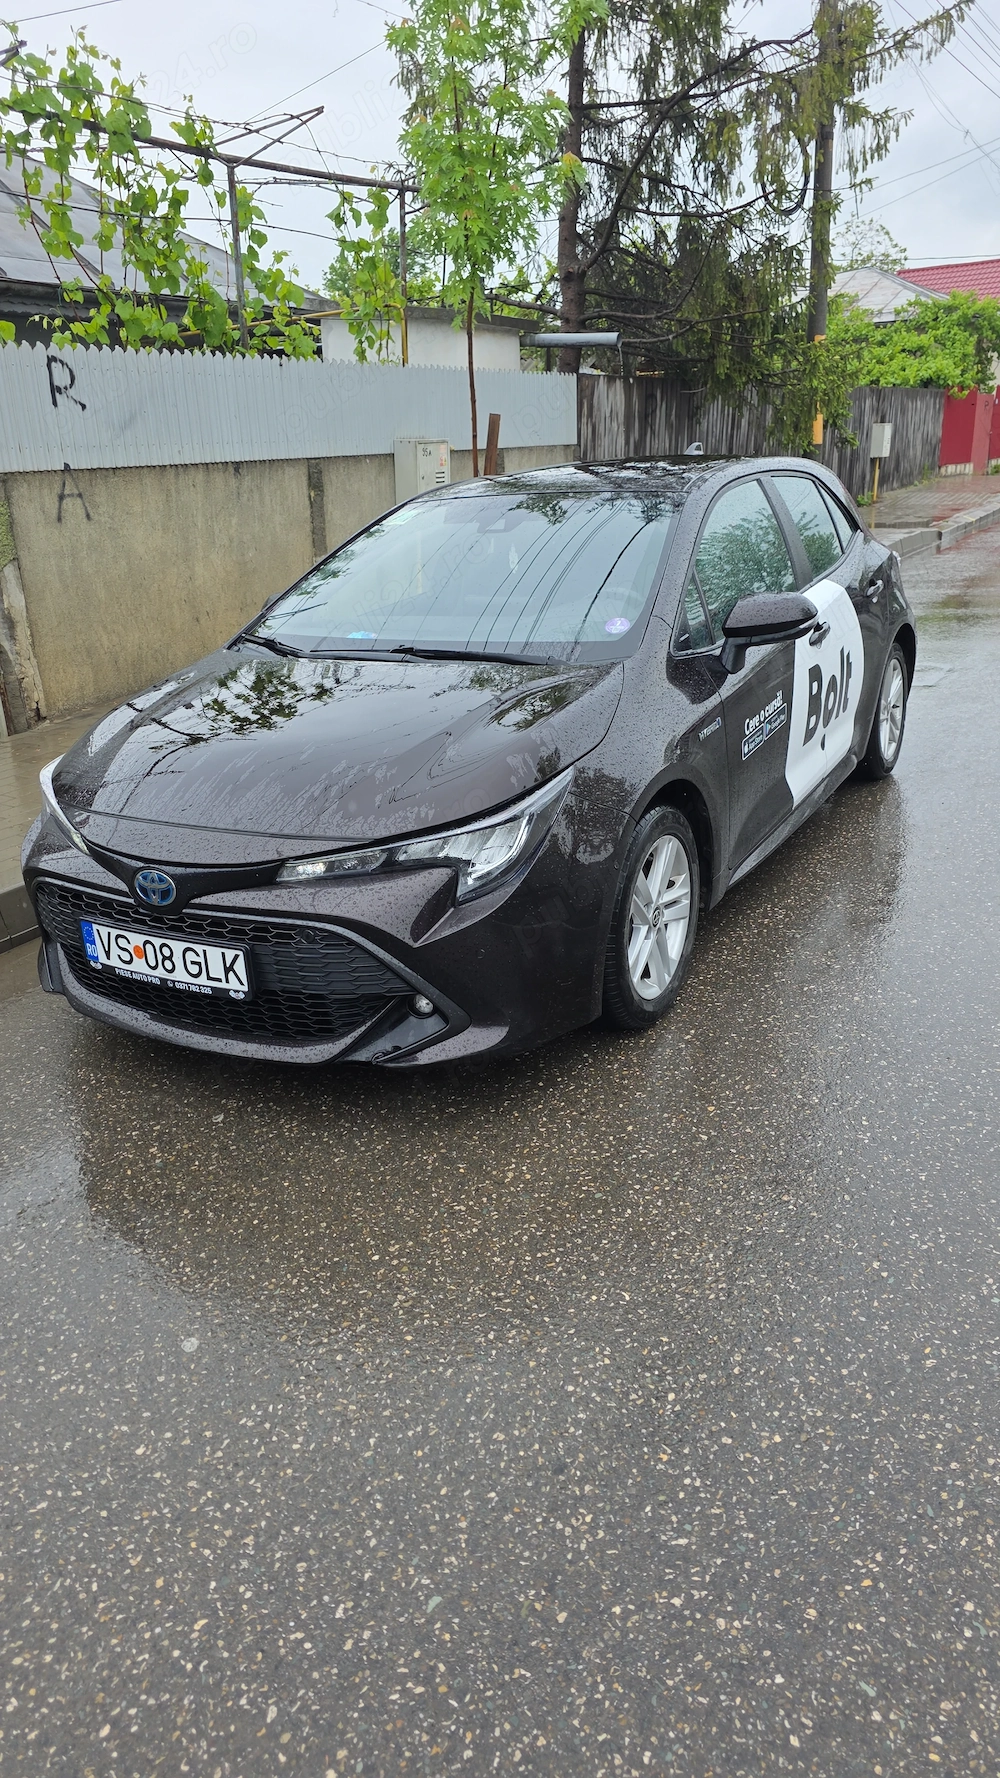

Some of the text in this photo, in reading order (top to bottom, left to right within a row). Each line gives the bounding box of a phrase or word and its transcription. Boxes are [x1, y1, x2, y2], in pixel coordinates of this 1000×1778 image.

[47, 354, 87, 412] R
[57, 462, 92, 523] A
[744, 718, 760, 736] Cere
[759, 710, 765, 722] o
[802, 645, 853, 747] Bolt
[86, 942, 98, 957] RO
[96, 929, 247, 987] VS 08 GLK
[132, 972, 148, 982] AUTO
[147, 976, 161, 985] PRO
